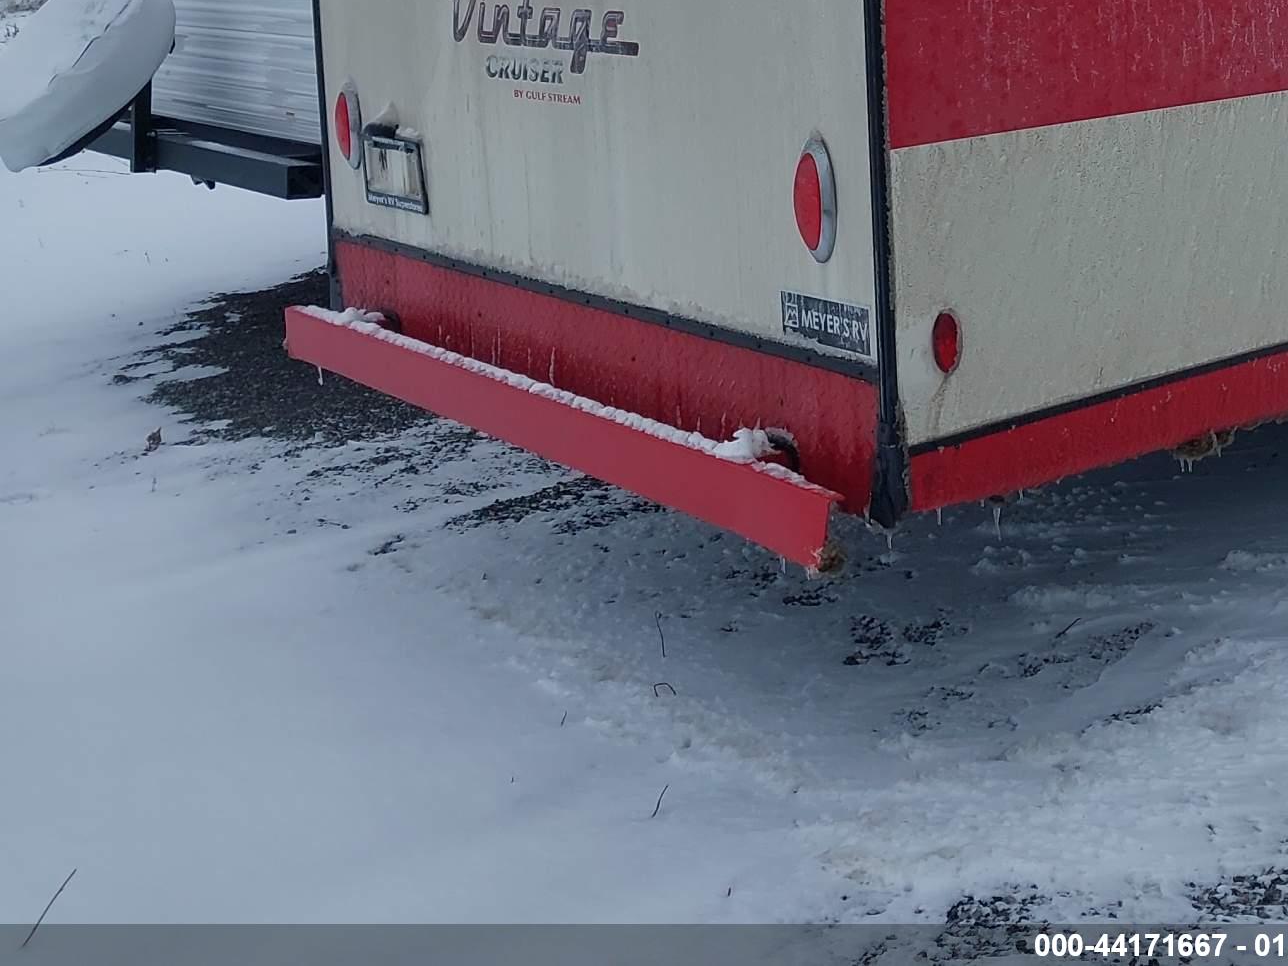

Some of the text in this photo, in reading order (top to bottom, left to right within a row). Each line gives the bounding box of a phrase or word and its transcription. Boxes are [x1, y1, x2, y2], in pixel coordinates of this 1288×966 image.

[486, 54, 564, 84] CRUISER
[513, 89, 581, 105] BY GULF STREAM
[801, 309, 868, 341] MEYER'S RV
